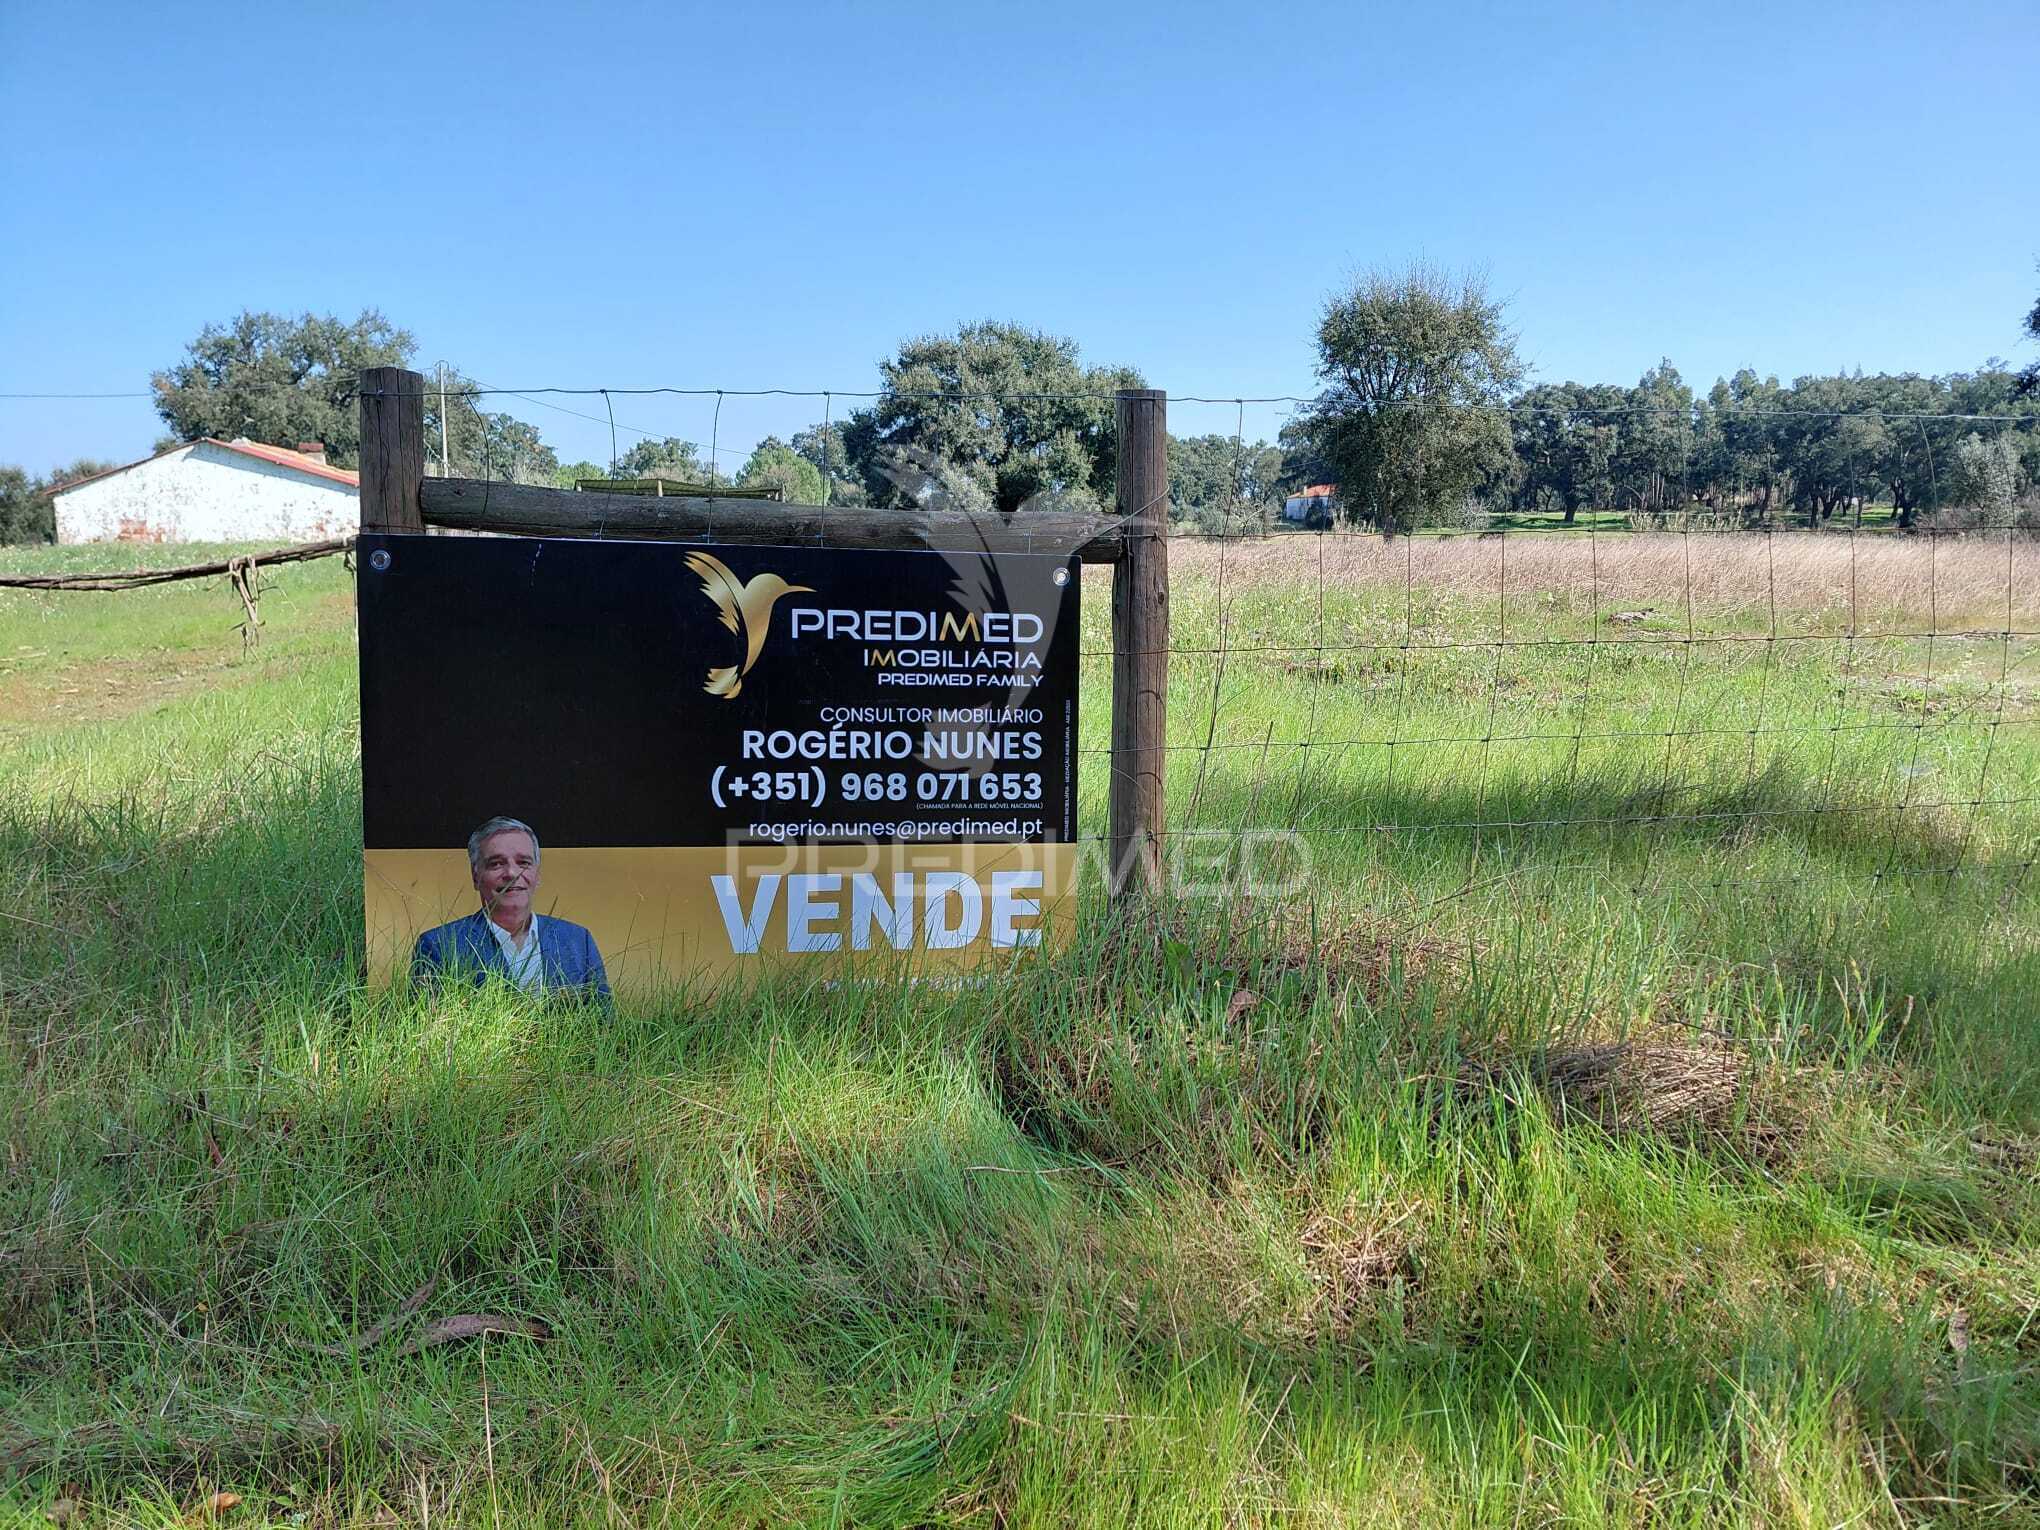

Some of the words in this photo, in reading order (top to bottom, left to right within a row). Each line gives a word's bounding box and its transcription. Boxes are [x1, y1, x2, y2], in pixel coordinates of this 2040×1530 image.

[791, 608, 1044, 643] PREDIMED
[863, 648, 1042, 669] IMOBILIÁRIA
[878, 672, 973, 687] PREDIMED
[976, 674, 1044, 688] FAMILY
[820, 706, 933, 723] CONSULTOR
[938, 704, 1044, 724] IMOBILIÁRIO
[742, 721, 914, 760] ROGÉRIO
[923, 730, 1043, 760] NUNES
[711, 765, 827, 809] (+351)
[840, 772, 908, 802] 968
[916, 772, 970, 801] 071
[979, 772, 1043, 801] 653
[749, 817, 1043, 842] rogerio.nunes@predimed.pt
[710, 870, 1043, 954] VENDE
